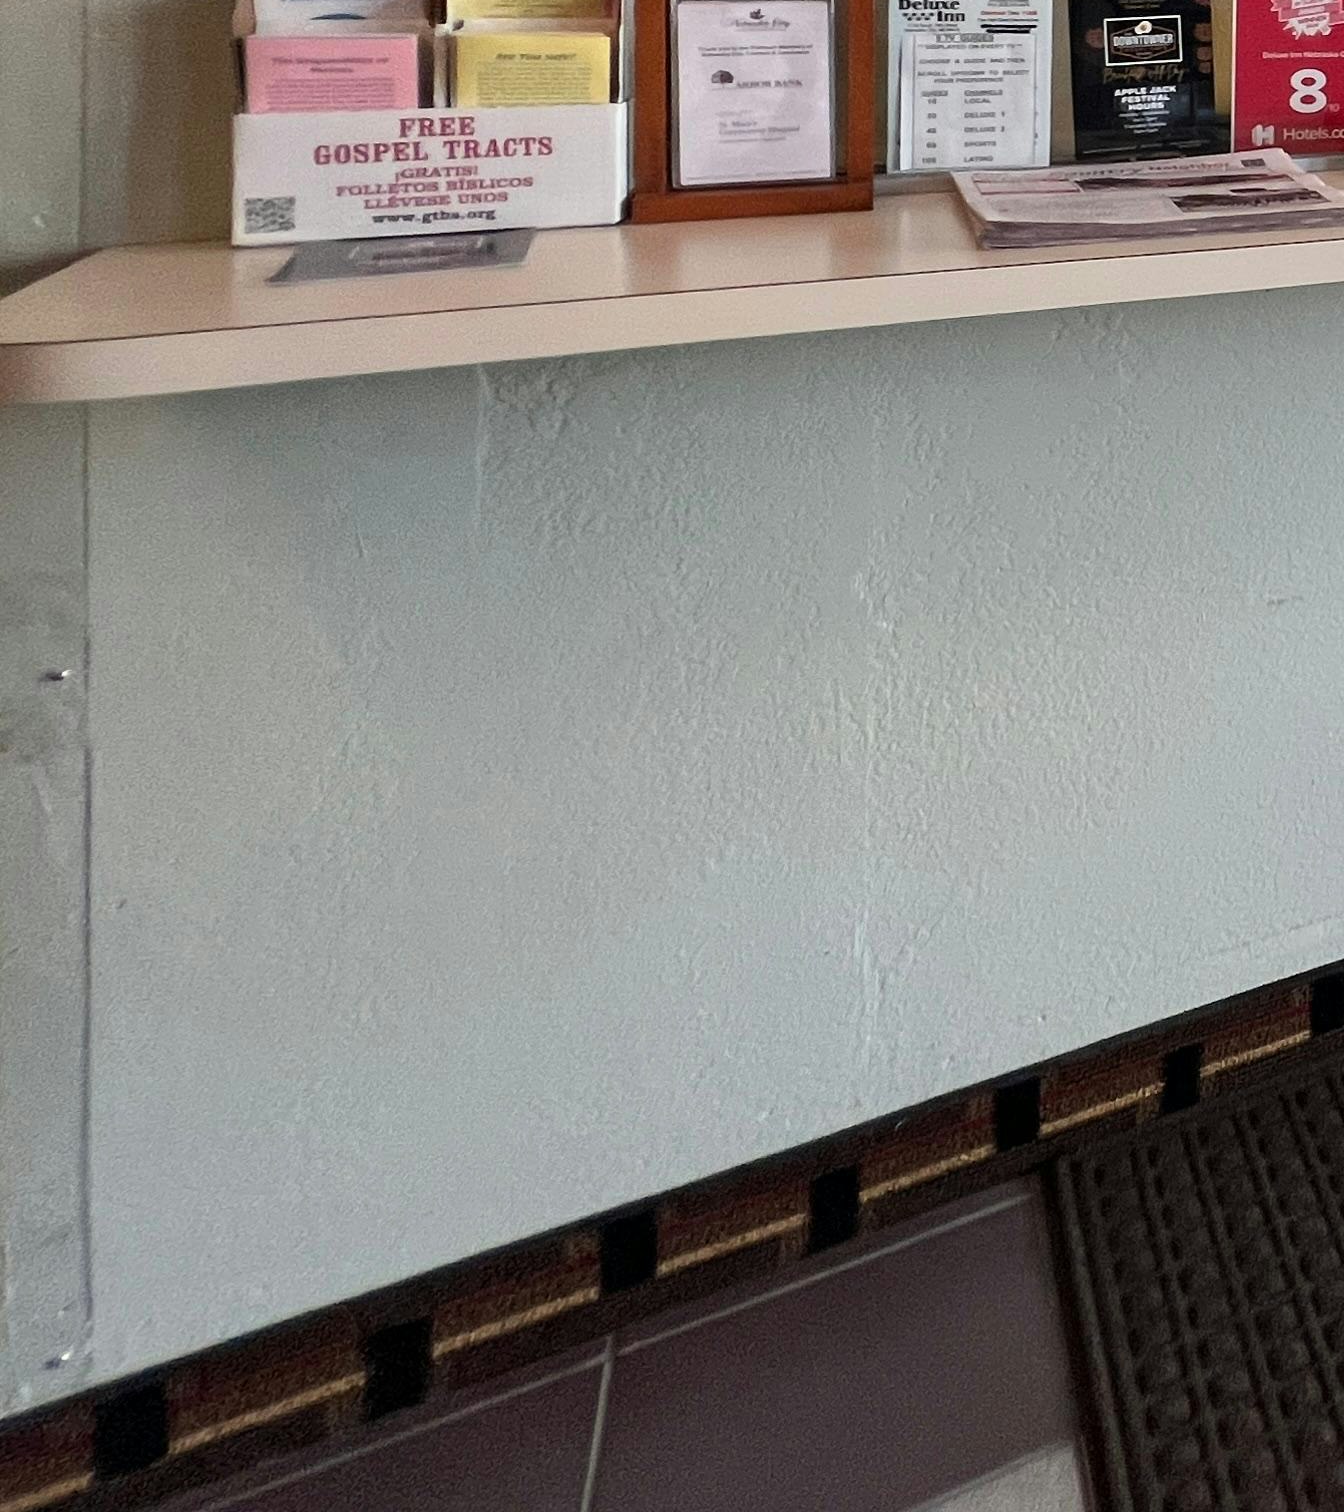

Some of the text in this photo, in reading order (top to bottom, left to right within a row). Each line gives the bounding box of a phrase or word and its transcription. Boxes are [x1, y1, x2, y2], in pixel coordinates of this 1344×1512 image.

[899, 0, 960, 10] Deluxe
[937, 11, 965, 22] Inn
[1114, 85, 1176, 96] APPLE JACK
[1289, 68, 1327, 114] 8
[1121, 94, 1170, 103] FESTIVAL
[1129, 102, 1164, 110] HOURS
[399, 117, 475, 138] FREE
[314, 137, 553, 165] GOSPEL TRACTS
